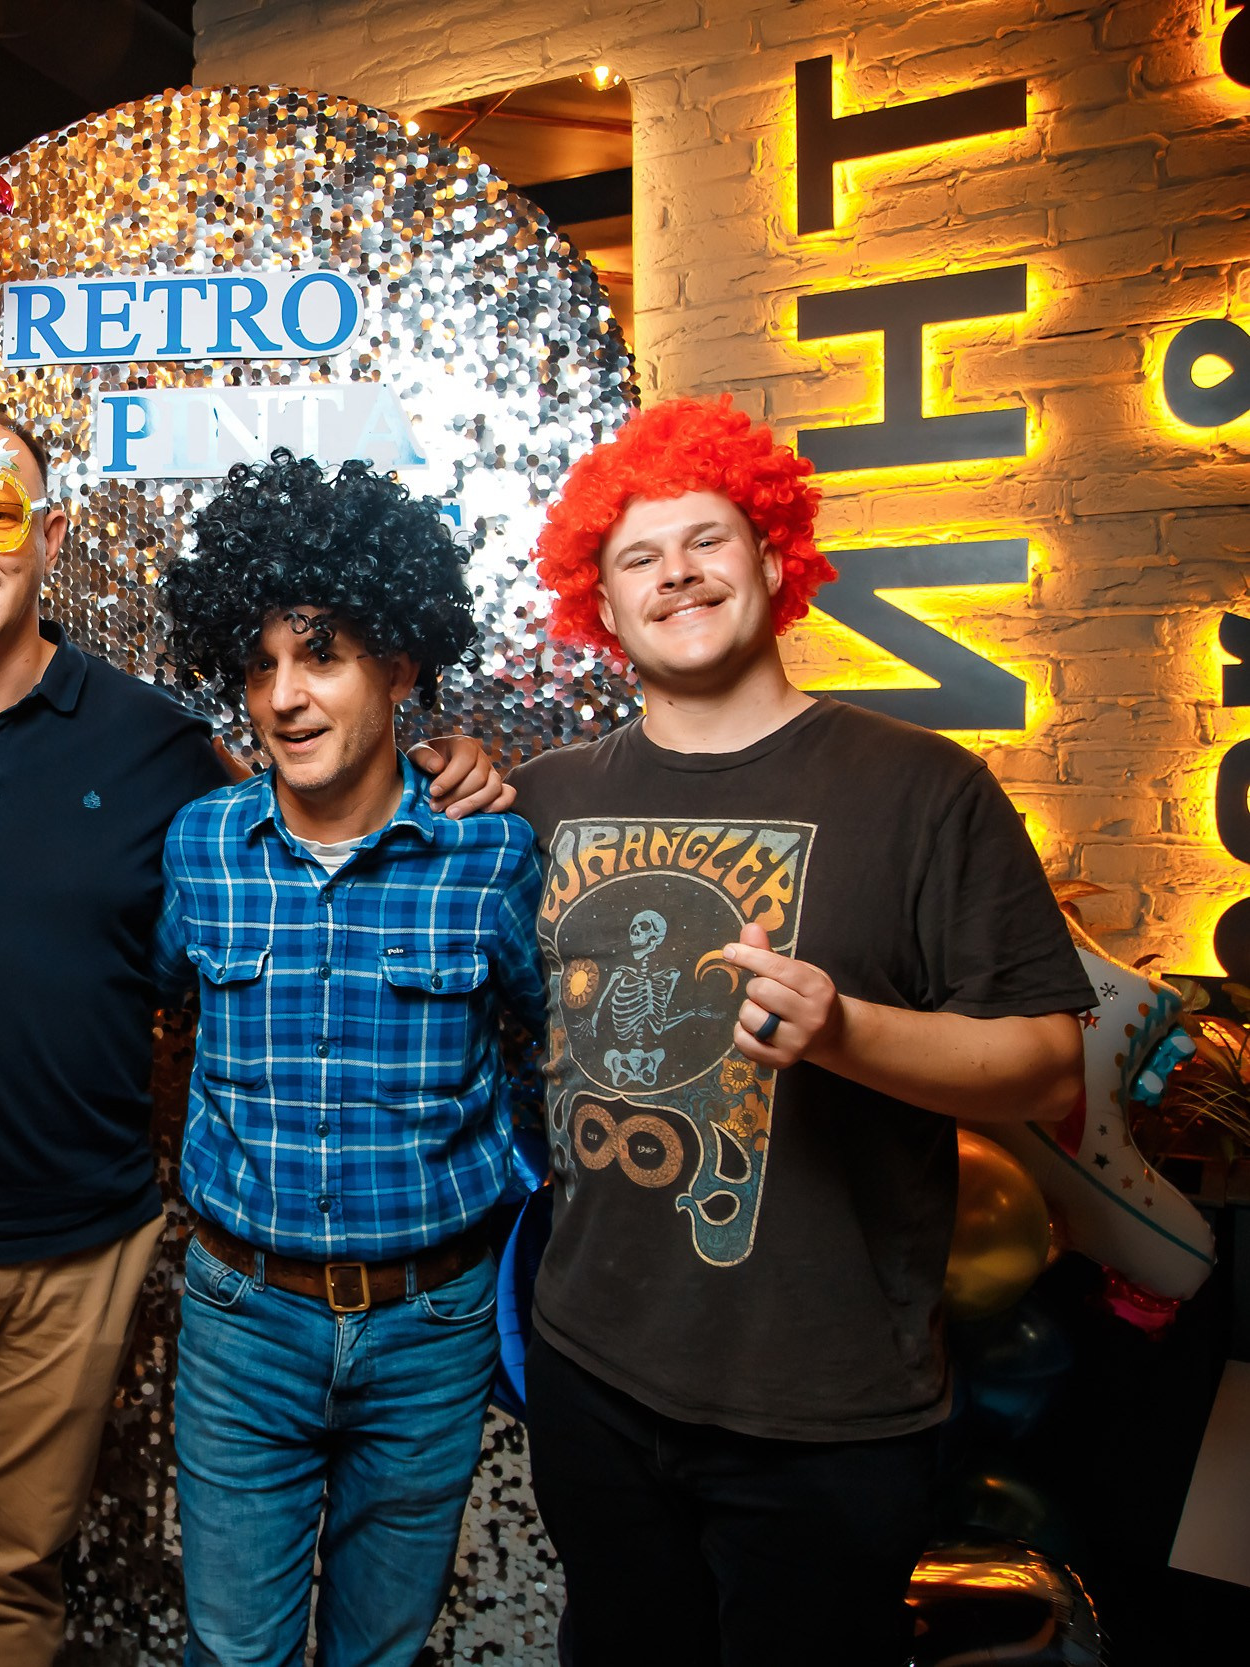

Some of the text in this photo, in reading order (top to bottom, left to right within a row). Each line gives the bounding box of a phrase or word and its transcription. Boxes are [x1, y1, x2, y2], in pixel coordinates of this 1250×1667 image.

[6, 271, 359, 361] RETRO
[101, 384, 428, 472] PINTA
[795, 54, 1028, 825] ИНТ
[541, 825, 801, 932] WRANGLER
[387, 947, 404, 955] Polo
